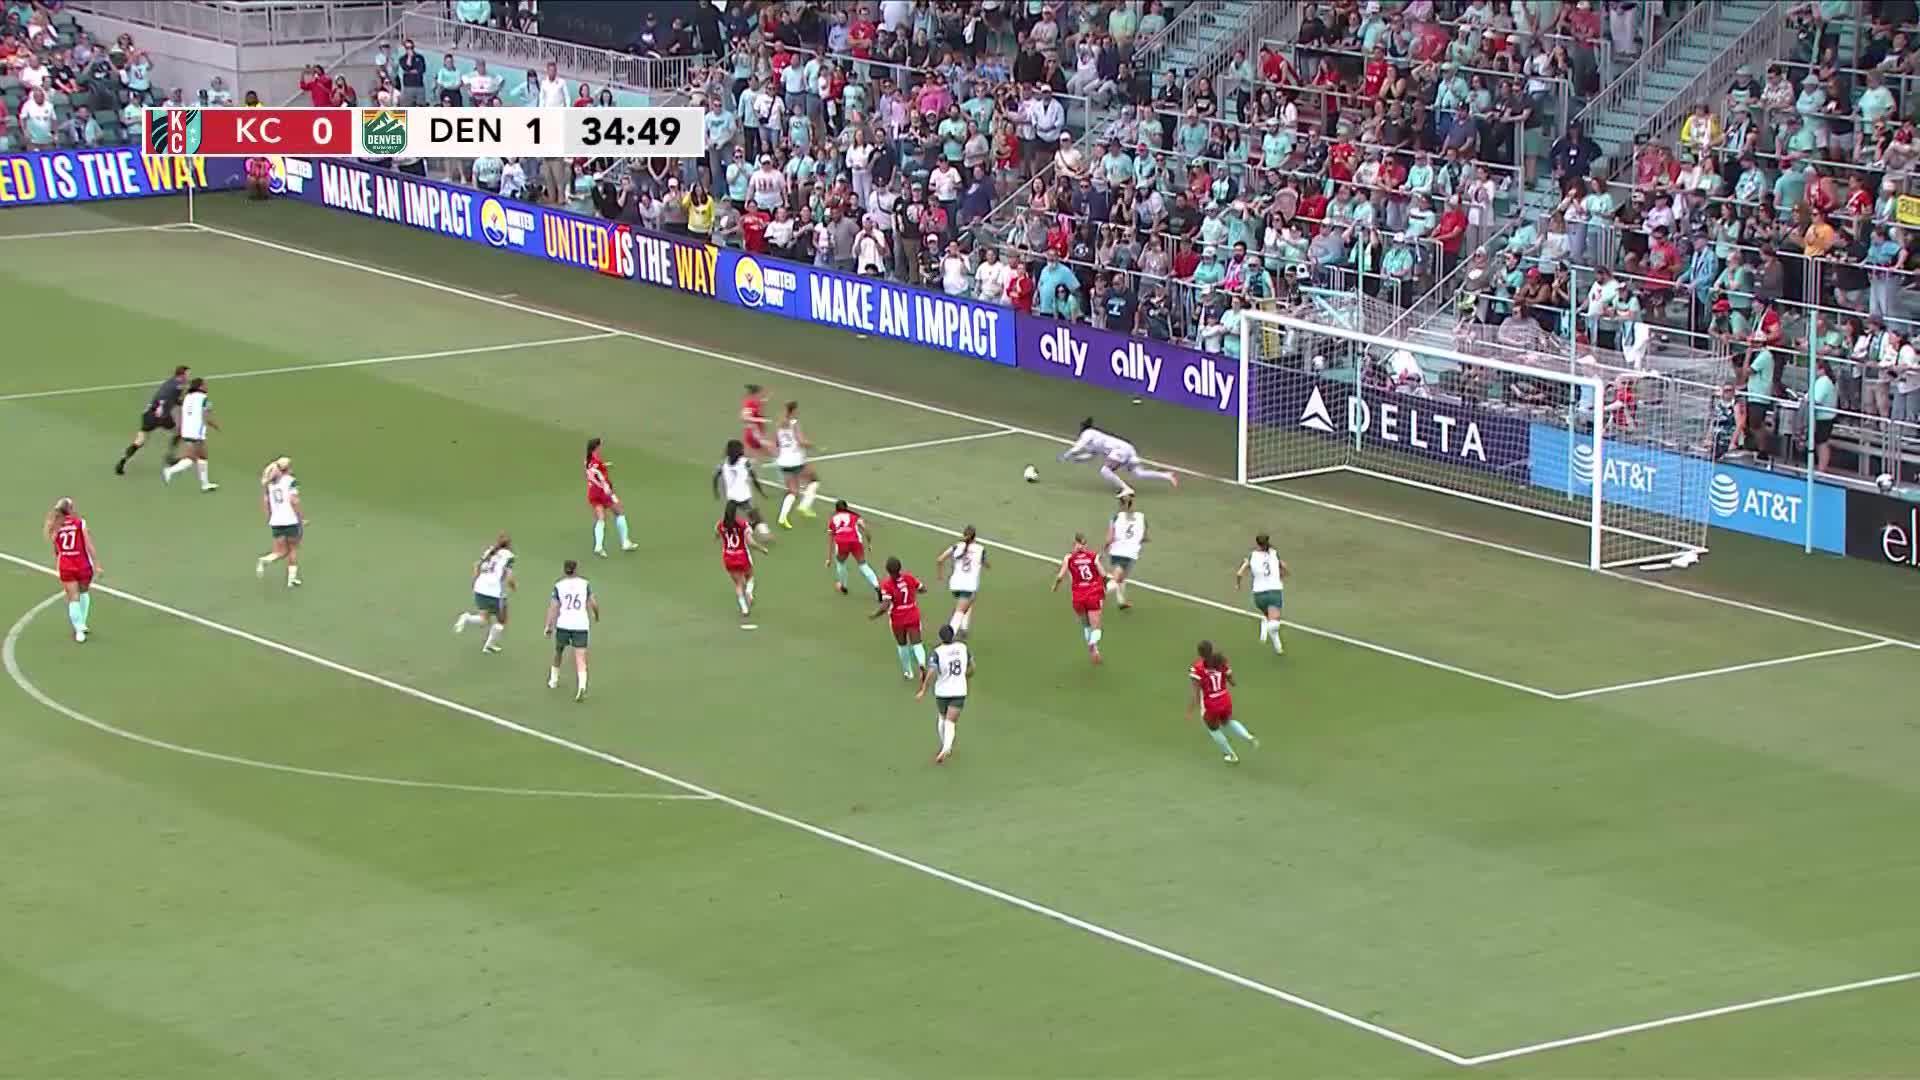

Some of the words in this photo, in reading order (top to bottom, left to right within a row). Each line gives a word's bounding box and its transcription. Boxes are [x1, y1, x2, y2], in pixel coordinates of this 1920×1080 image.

[40, 155, 78, 199] IS
[79, 151, 140, 197] THE
[320, 162, 373, 215] MAKE
[376, 175, 401, 221] AN
[403, 181, 473, 238] IMPACT
[543, 212, 610, 270] UNITED
[614, 229, 634, 276] IS
[636, 234, 673, 286] THE
[674, 243, 719, 296] WAY
[809, 272, 874, 331] MAKE
[879, 287, 910, 339] AN
[914, 295, 999, 358] IMPACT
[1040, 327, 1088, 377] ally
[1111, 342, 1163, 393] ally
[1184, 358, 1234, 410] ally
[1348, 395, 1487, 462] DELTA
[1602, 458, 1657, 492] AT&T
[1743, 487, 1804, 524] AT&T
[60, 530, 76, 550] 27
[1262, 561, 1271, 577] 3
[564, 593, 582, 610] 26
[900, 587, 909, 604] 7
[948, 659, 962, 677] 18
